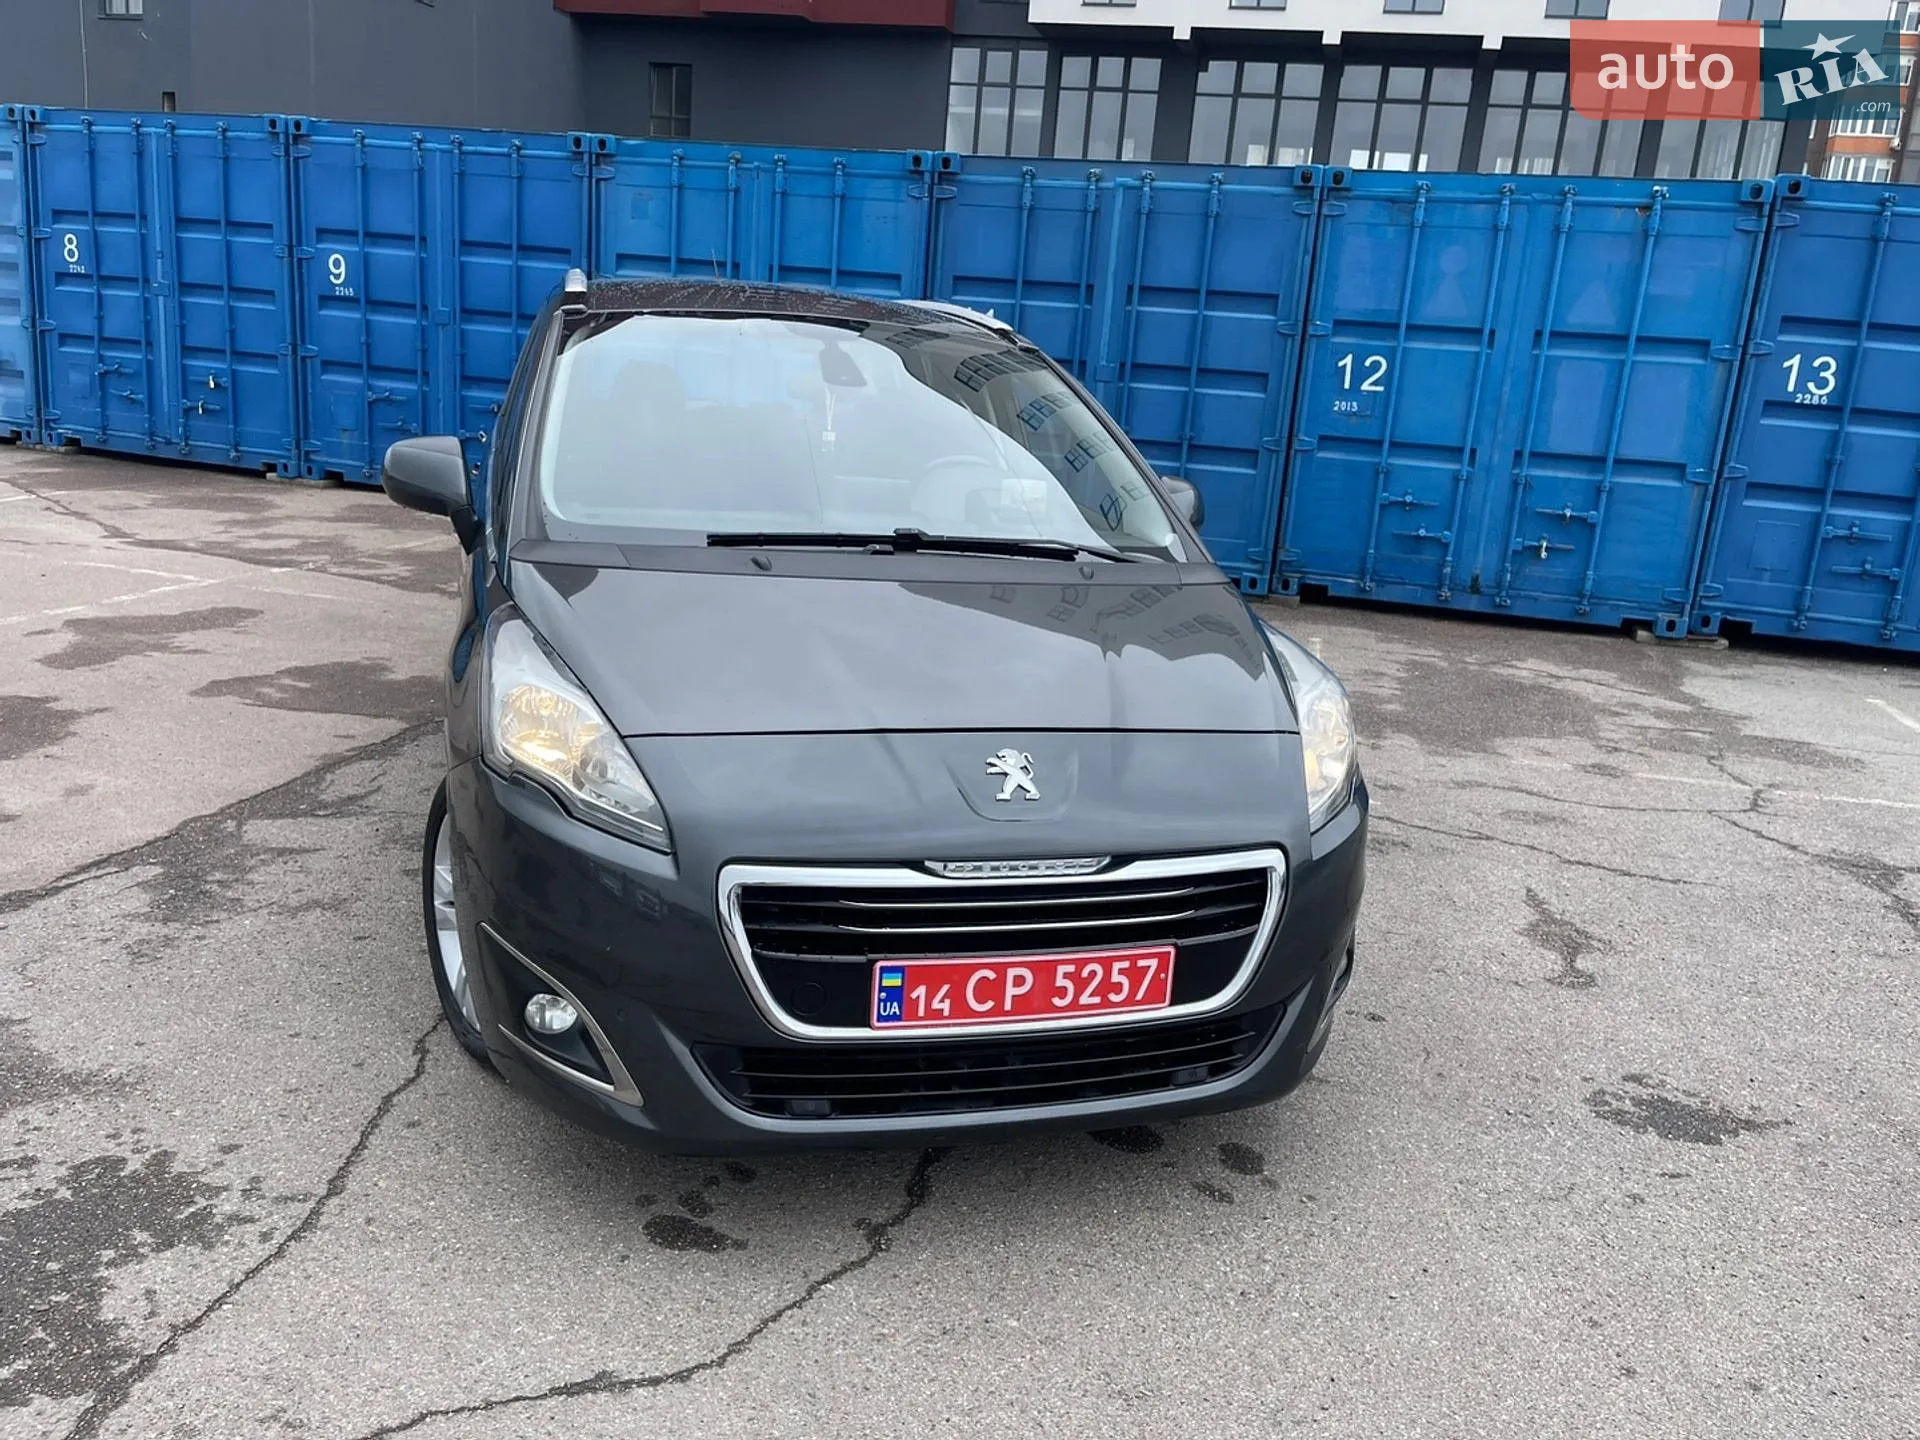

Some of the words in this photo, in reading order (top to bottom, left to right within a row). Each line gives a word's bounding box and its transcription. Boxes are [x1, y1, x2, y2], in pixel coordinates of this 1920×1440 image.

[64, 233, 79, 263] 8
[328, 253, 345, 284] 9
[1337, 353, 1387, 391] 12
[1782, 353, 1837, 395] 13
[1795, 393, 1828, 405] 2286
[910, 984, 951, 1017] 14
[965, 966, 1034, 1012] CP
[1051, 957, 1159, 1008] 5257
[879, 1000, 900, 1016] UA
